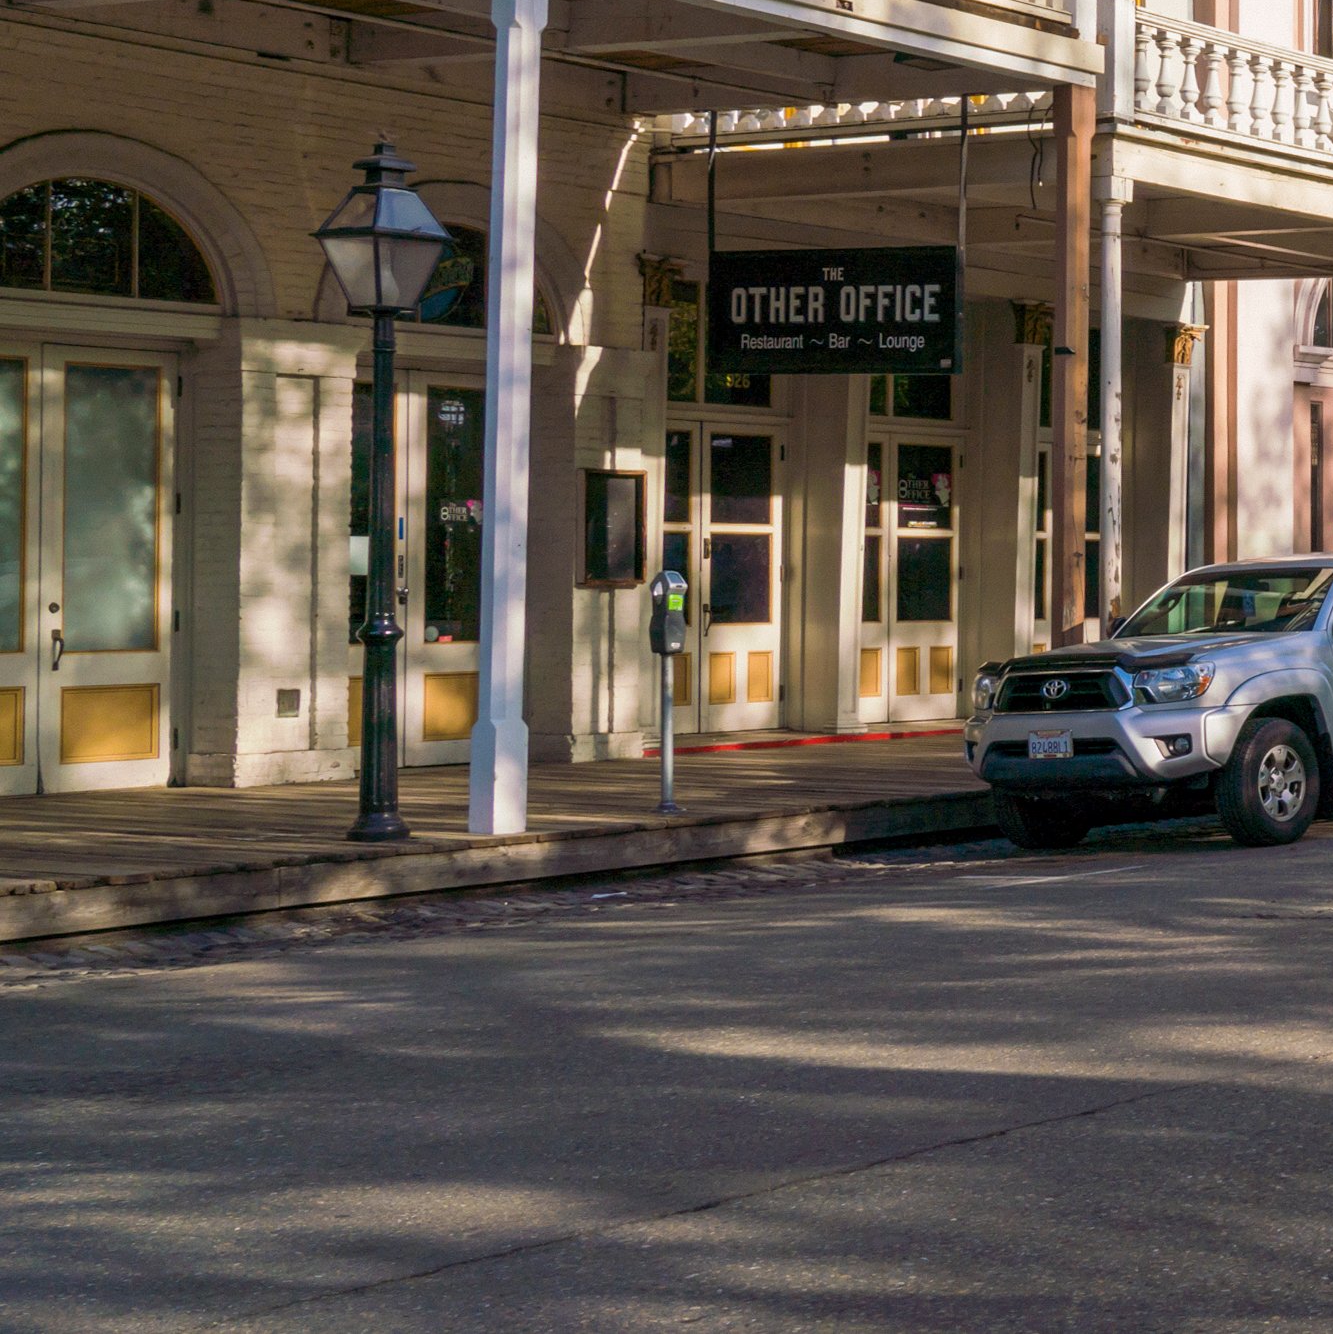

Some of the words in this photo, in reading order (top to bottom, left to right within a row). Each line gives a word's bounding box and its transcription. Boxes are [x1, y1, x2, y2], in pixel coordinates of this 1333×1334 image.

[822, 267, 845, 281] THE
[731, 286, 826, 324] OTHER
[839, 283, 942, 323] OFFICE
[740, 333, 804, 349] Restaurant
[828, 333, 851, 349] Bar
[878, 332, 926, 352] Lounge
